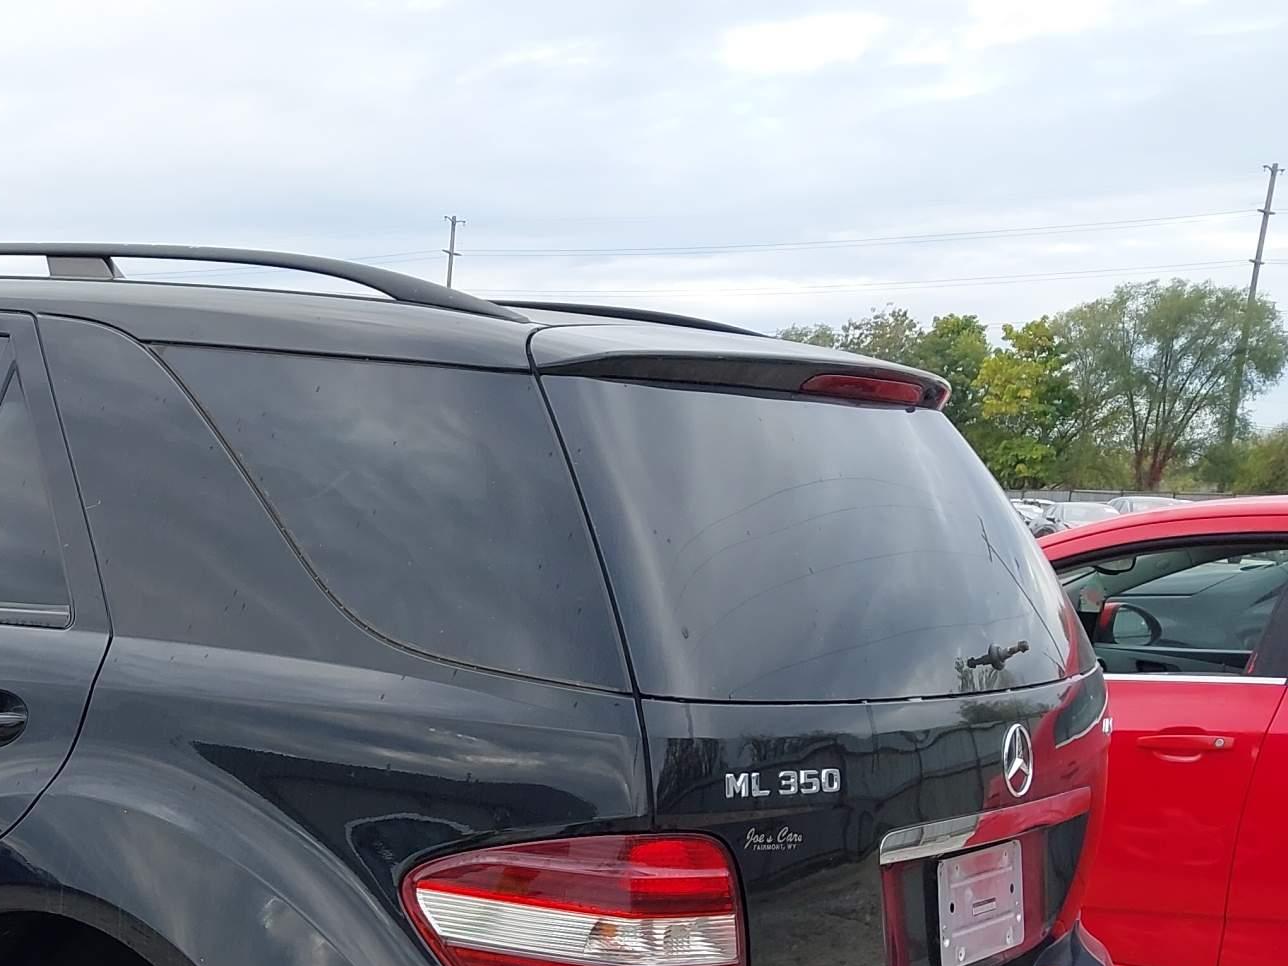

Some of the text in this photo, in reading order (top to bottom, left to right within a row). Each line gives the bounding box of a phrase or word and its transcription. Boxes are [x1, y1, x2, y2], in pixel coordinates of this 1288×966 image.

[725, 768, 841, 798] ML 350
[744, 826, 803, 849] Joes Cars
